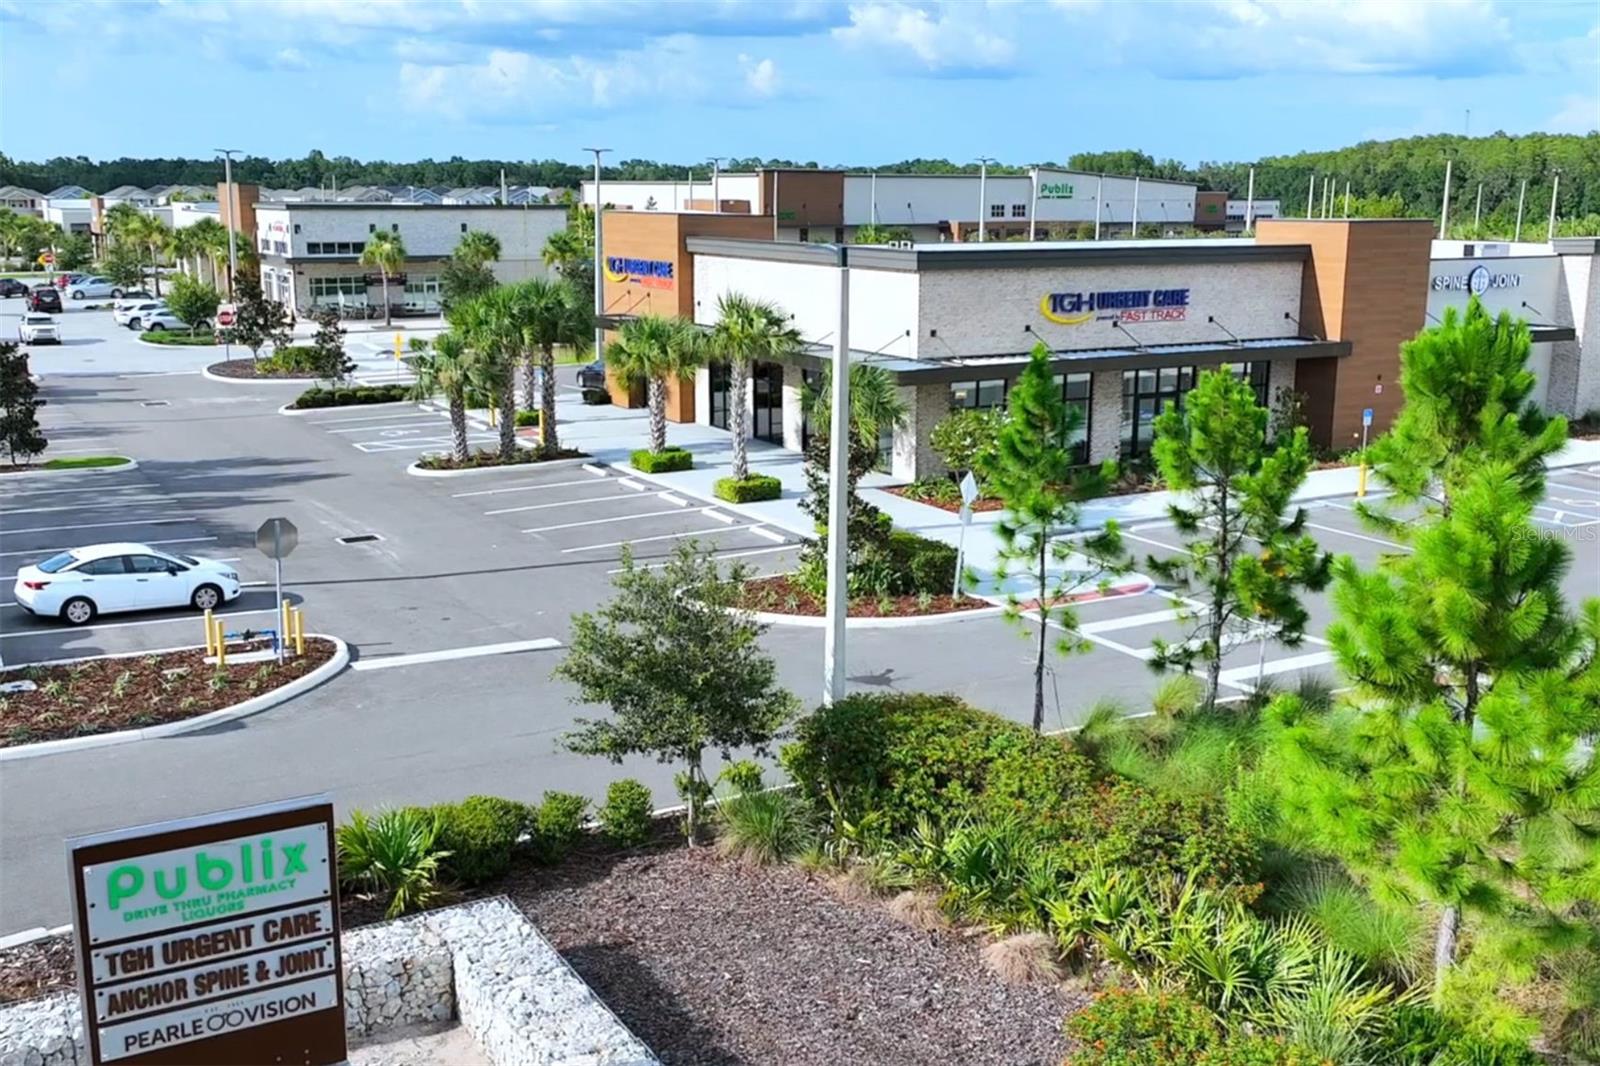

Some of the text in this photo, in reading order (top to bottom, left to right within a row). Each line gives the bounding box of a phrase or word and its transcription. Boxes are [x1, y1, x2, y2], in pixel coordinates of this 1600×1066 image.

[1040, 183, 1073, 194] Publix
[1432, 275, 1468, 290] SPINE
[1049, 289, 1190, 313] TGH URGENT CARE
[1121, 311, 1147, 321] FAST
[1151, 309, 1185, 319] TRACK
[106, 838, 308, 911] Publix
[123, 878, 297, 922] DRIVE THRU PHARMACY
[181, 900, 245, 922] LIQUORS
[104, 910, 322, 977] TGH URGENT CARE
[107, 946, 327, 1016] ANCHOR SPINE & JOINT
[124, 992, 316, 1052] PEARLE VISION
